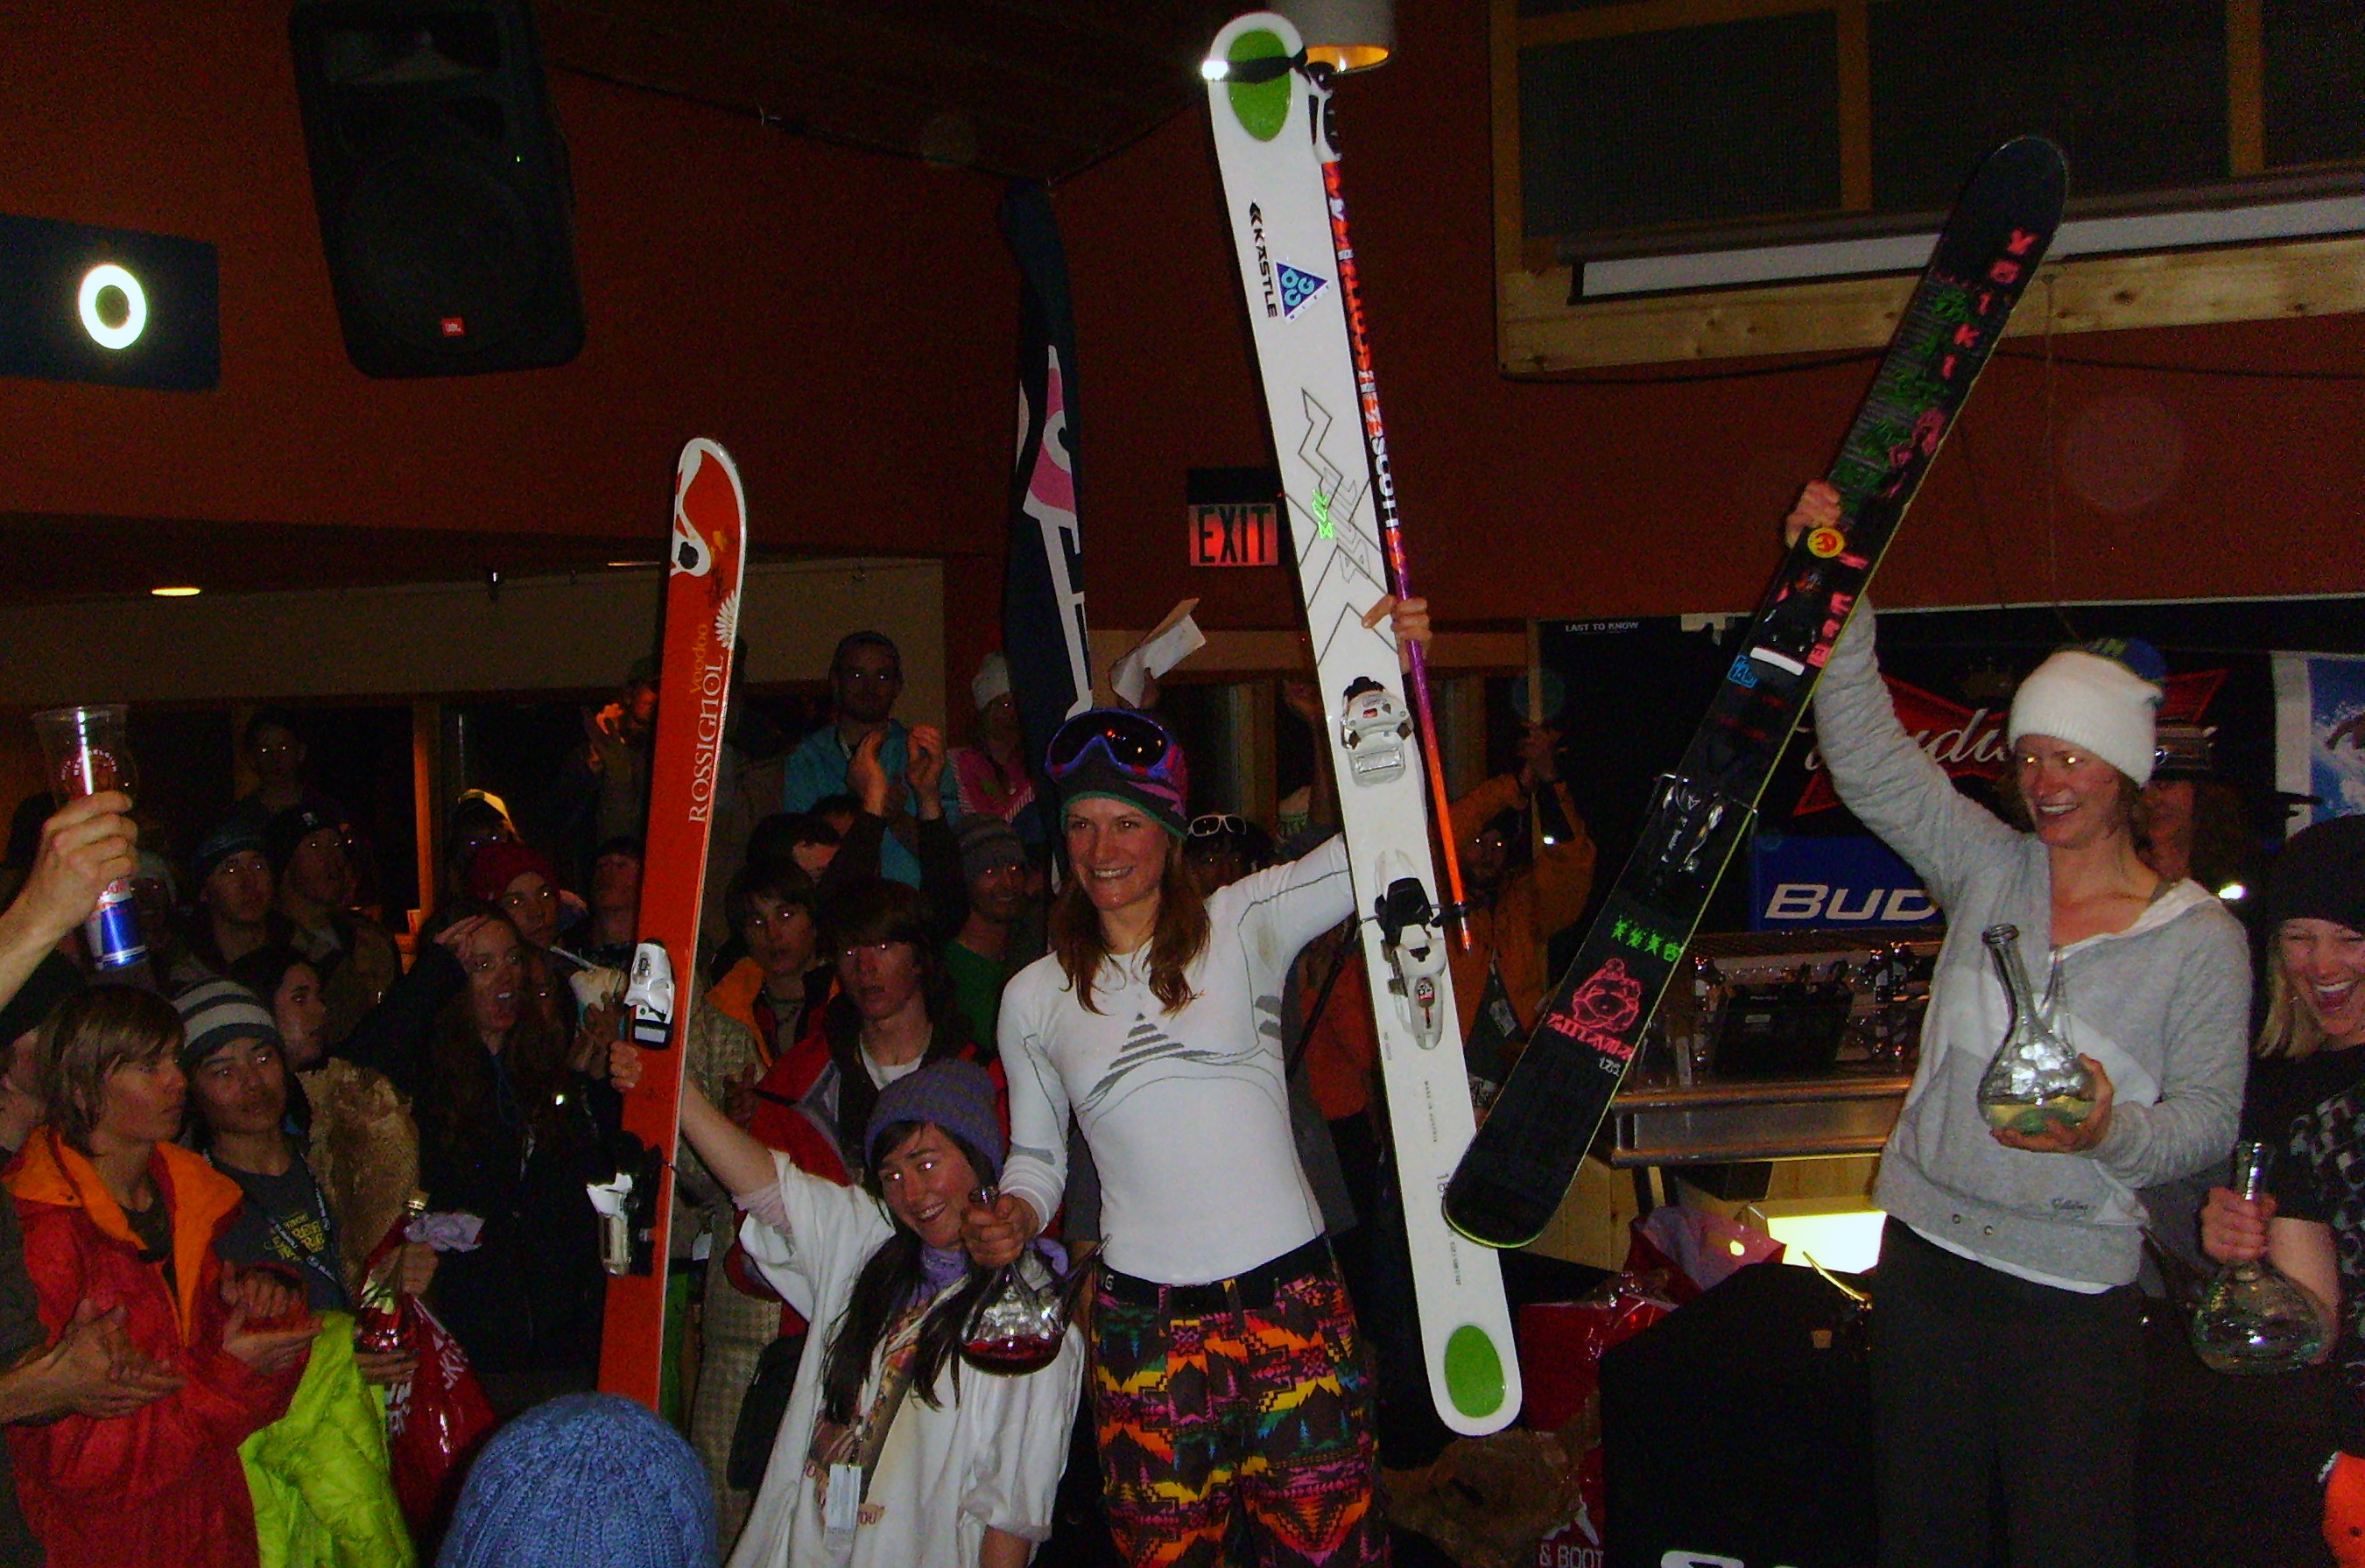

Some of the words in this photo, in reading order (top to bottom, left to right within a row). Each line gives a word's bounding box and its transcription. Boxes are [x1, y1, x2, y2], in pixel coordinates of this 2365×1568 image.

[1198, 506, 1272, 563] EXIT
[1592, 622, 1606, 630] TO
[687, 654, 724, 823] ROSSIGNOL
